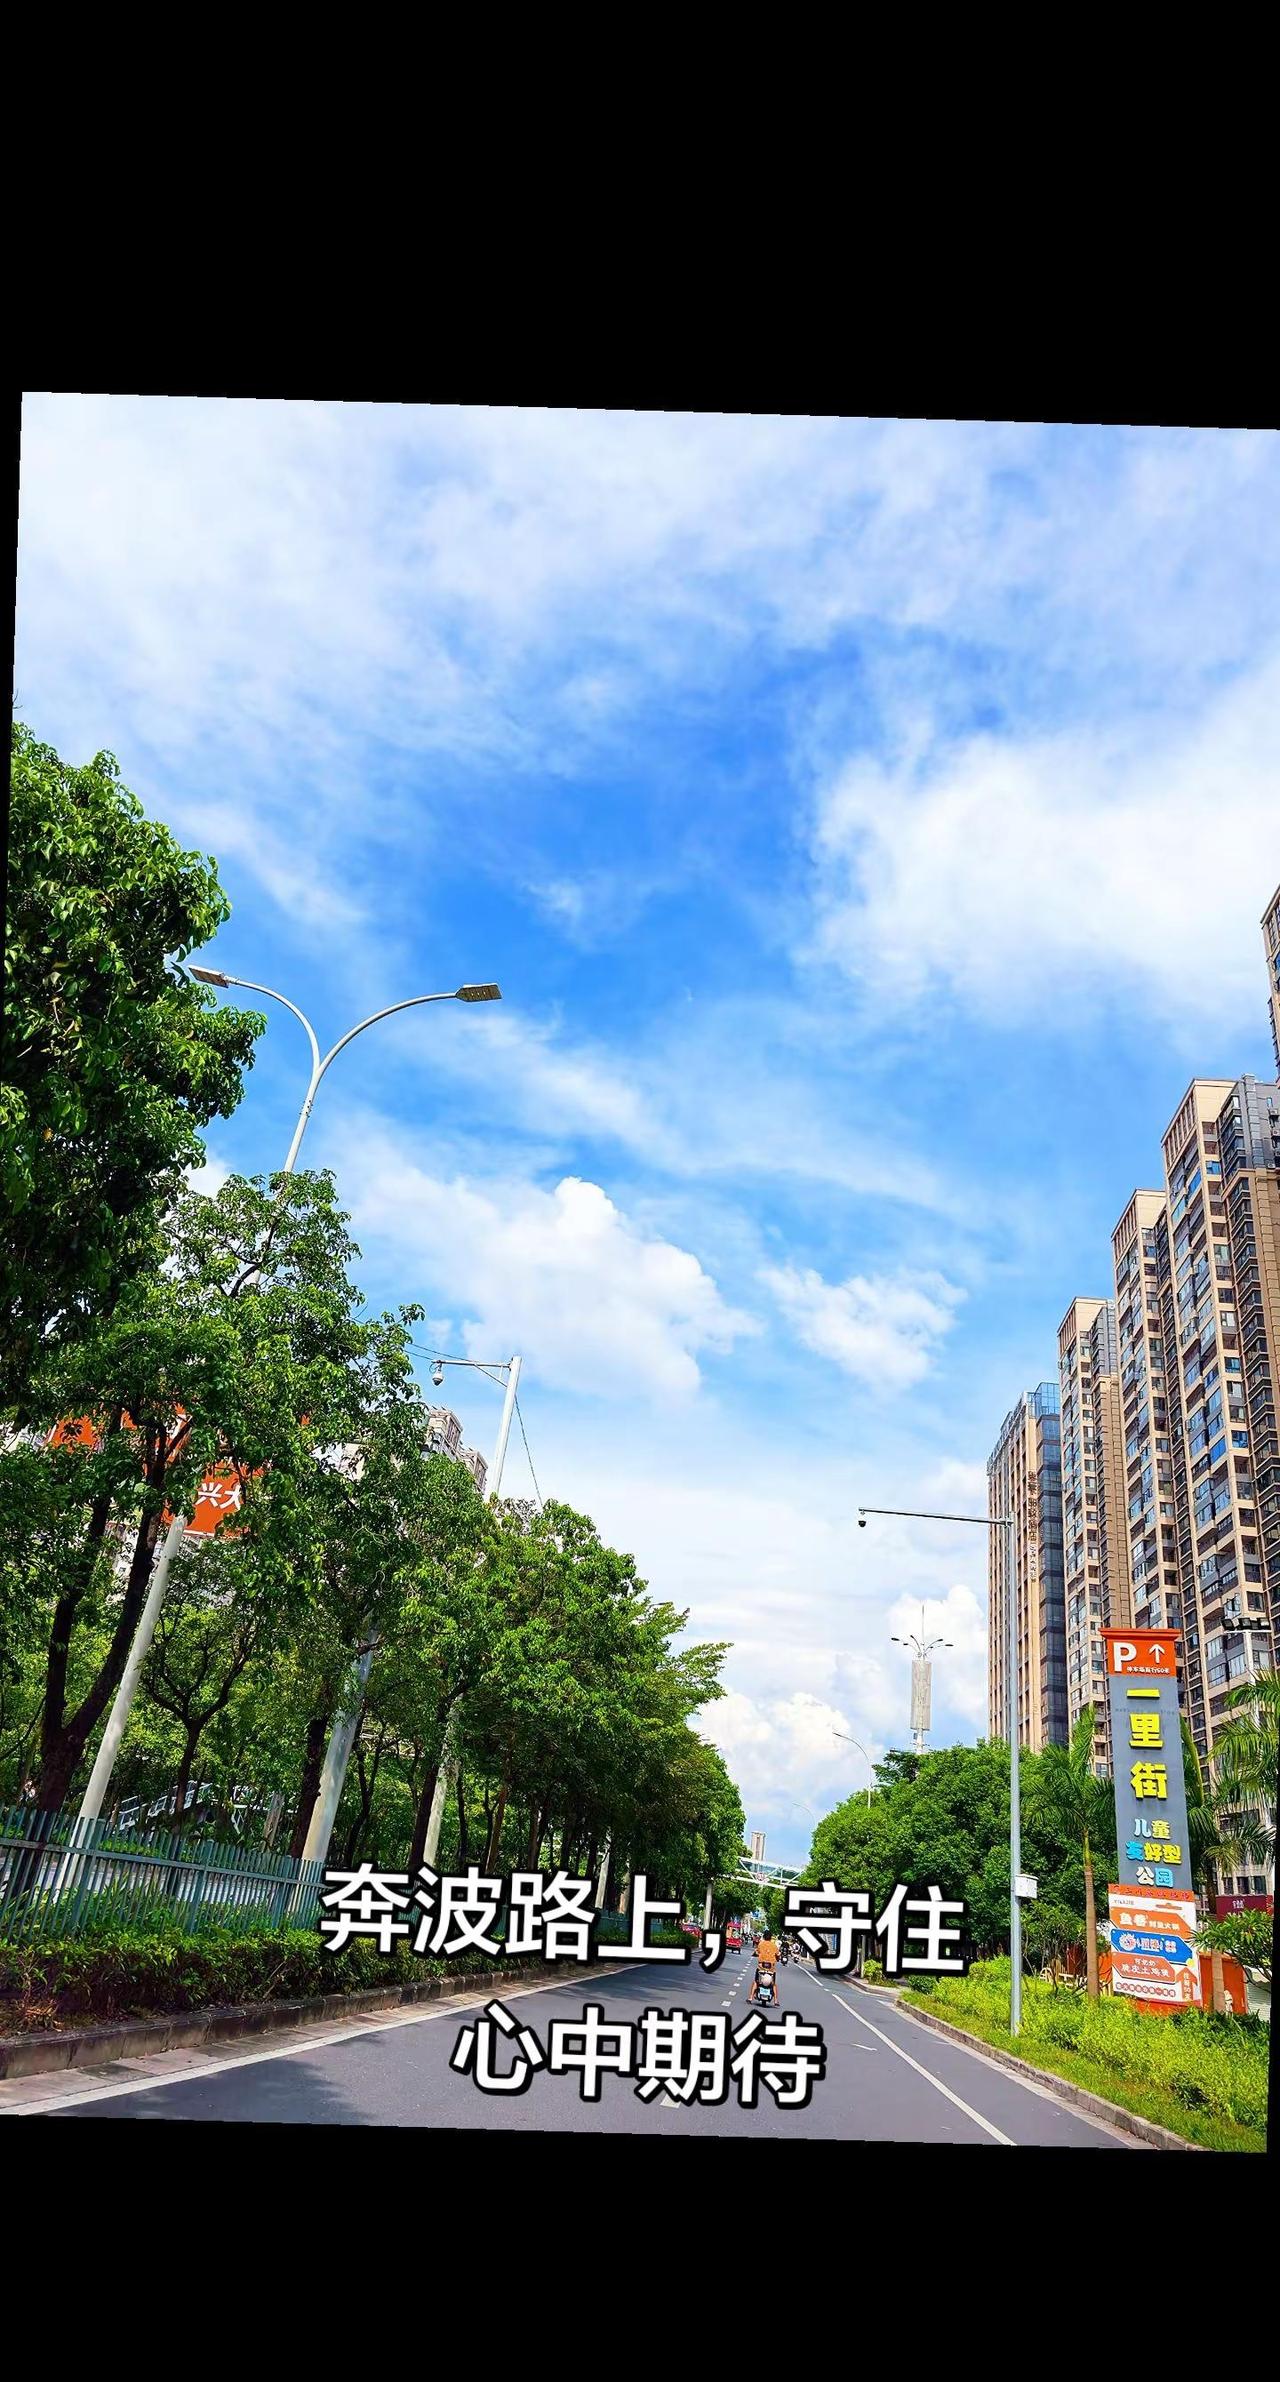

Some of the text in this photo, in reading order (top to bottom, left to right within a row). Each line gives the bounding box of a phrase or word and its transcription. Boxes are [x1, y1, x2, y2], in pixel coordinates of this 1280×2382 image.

[1113, 1642, 1137, 1672] P
[1126, 1689, 1168, 1800] 一里街
[1134, 1819, 1171, 1839] 儿童
[1126, 1841, 1182, 1864] 友好型
[1136, 1867, 1174, 1888] 公园
